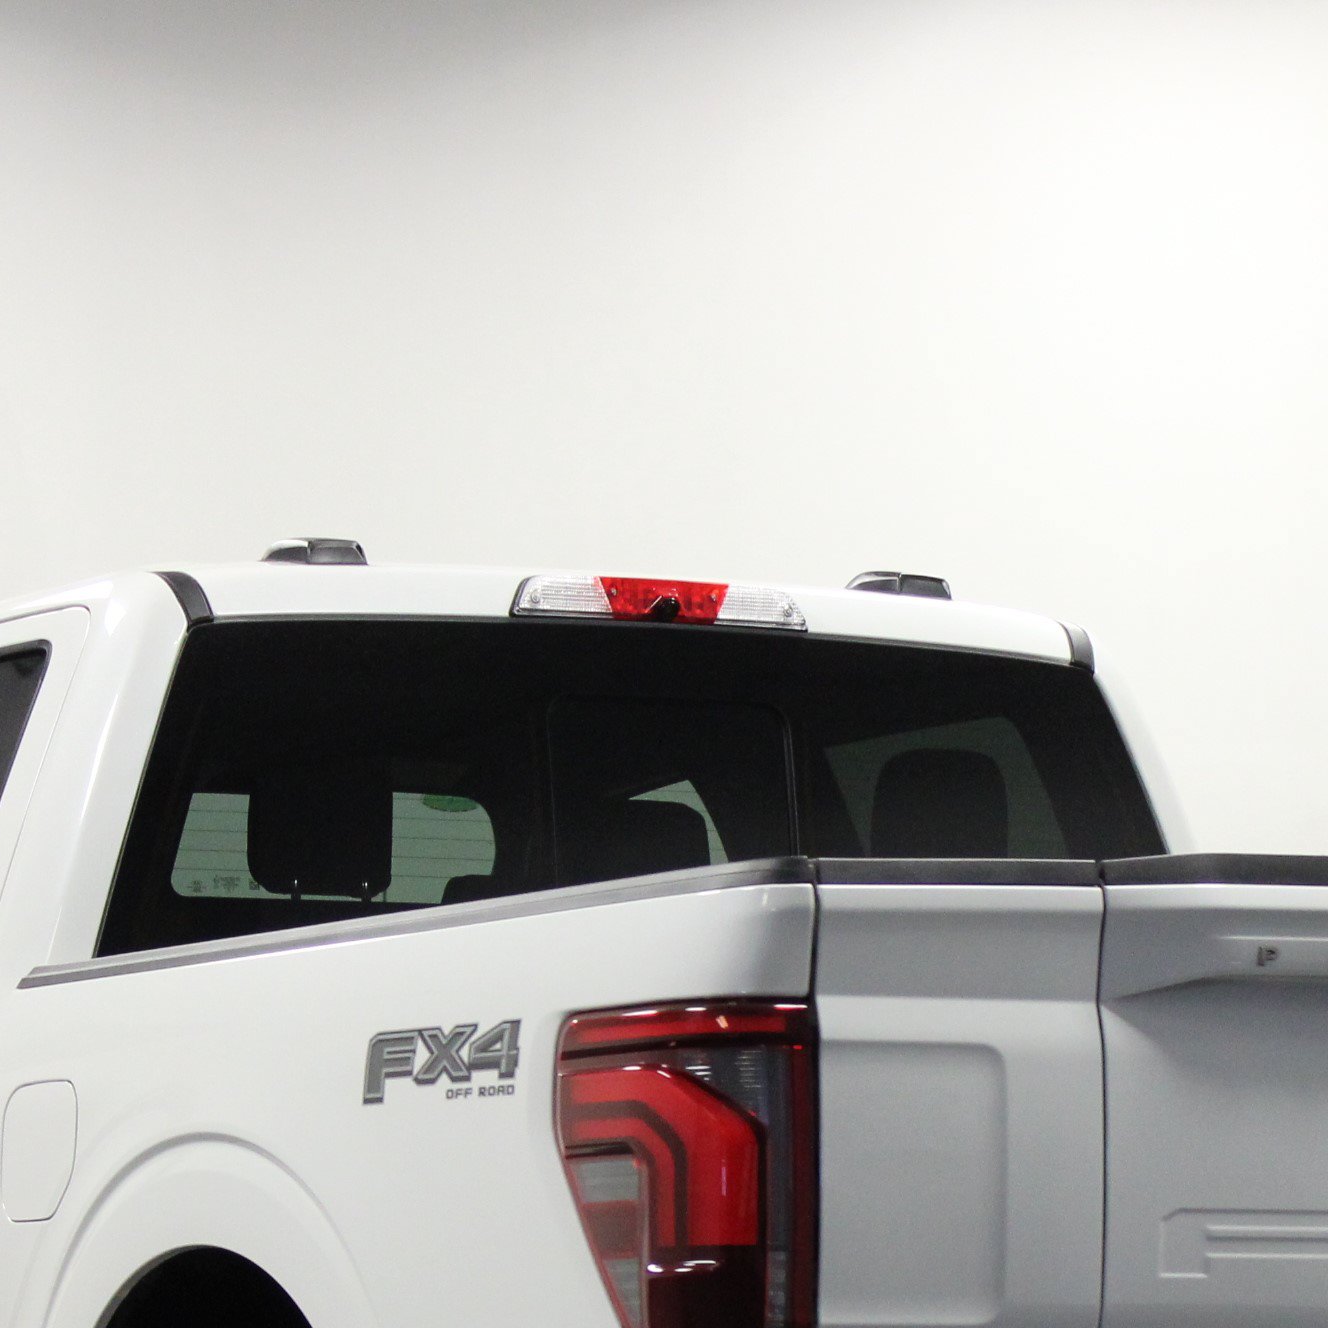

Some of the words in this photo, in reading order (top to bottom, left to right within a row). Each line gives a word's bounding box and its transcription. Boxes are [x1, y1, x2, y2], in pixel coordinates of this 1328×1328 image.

[362, 1018, 522, 1105] FX4
[445, 1087, 473, 1100] OFF
[478, 1084, 516, 1098] ROAD
